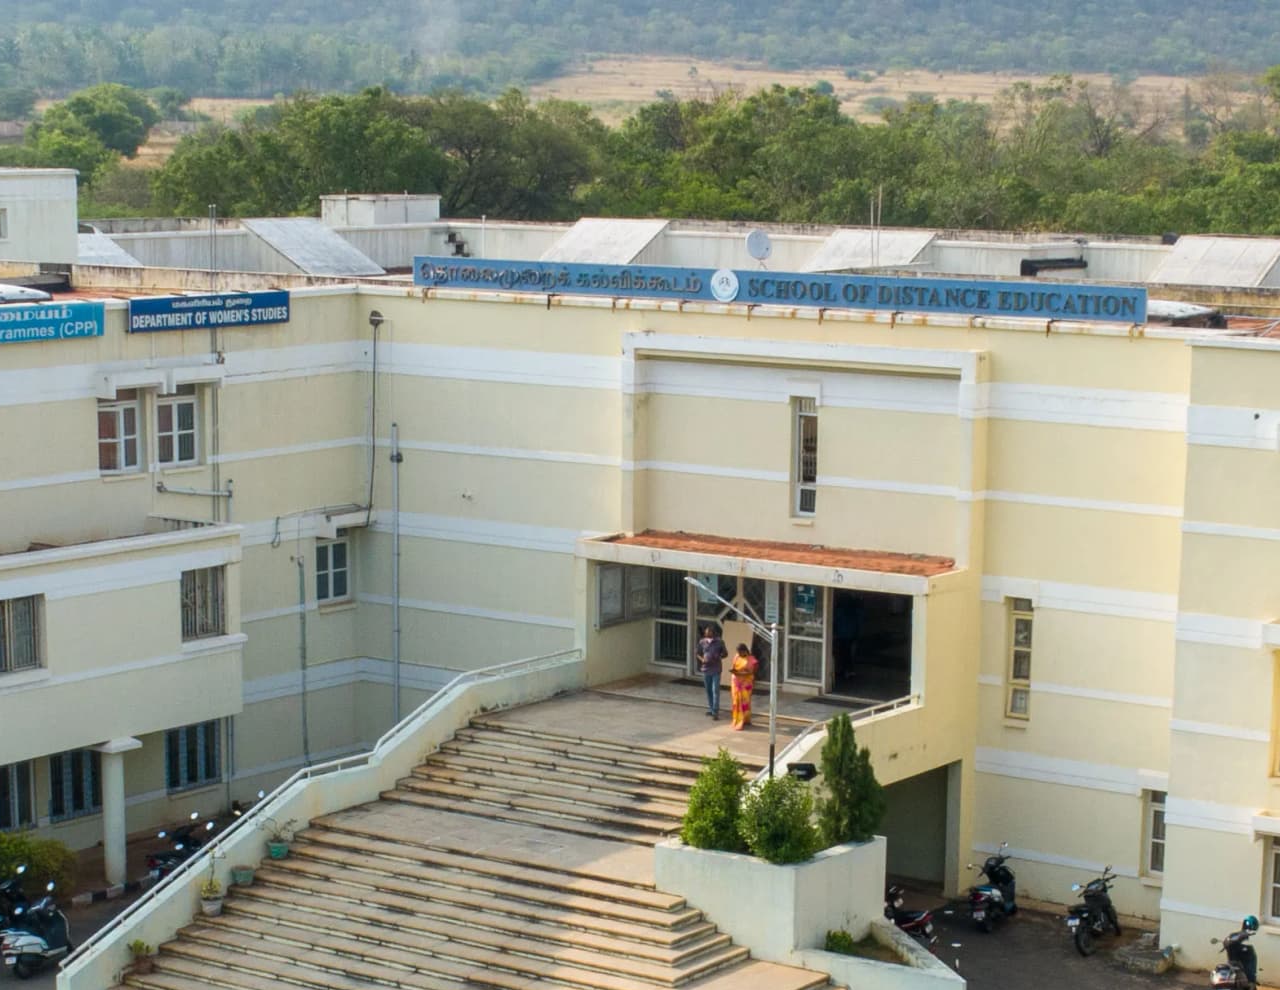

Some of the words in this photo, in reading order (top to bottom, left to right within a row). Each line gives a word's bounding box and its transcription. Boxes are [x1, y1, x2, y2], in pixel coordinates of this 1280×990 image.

[747, 277, 840, 302] SCHOOL
[842, 280, 872, 303] OF
[877, 284, 991, 310] DISTANCE
[998, 290, 1138, 316] EDUCATION
[132, 312, 194, 329] DEPARTMENT
[195, 311, 207, 325] OF
[209, 309, 250, 323] WOMEN'S
[251, 306, 288, 320] STUDIES
[59, 320, 99, 339] (CPP)
